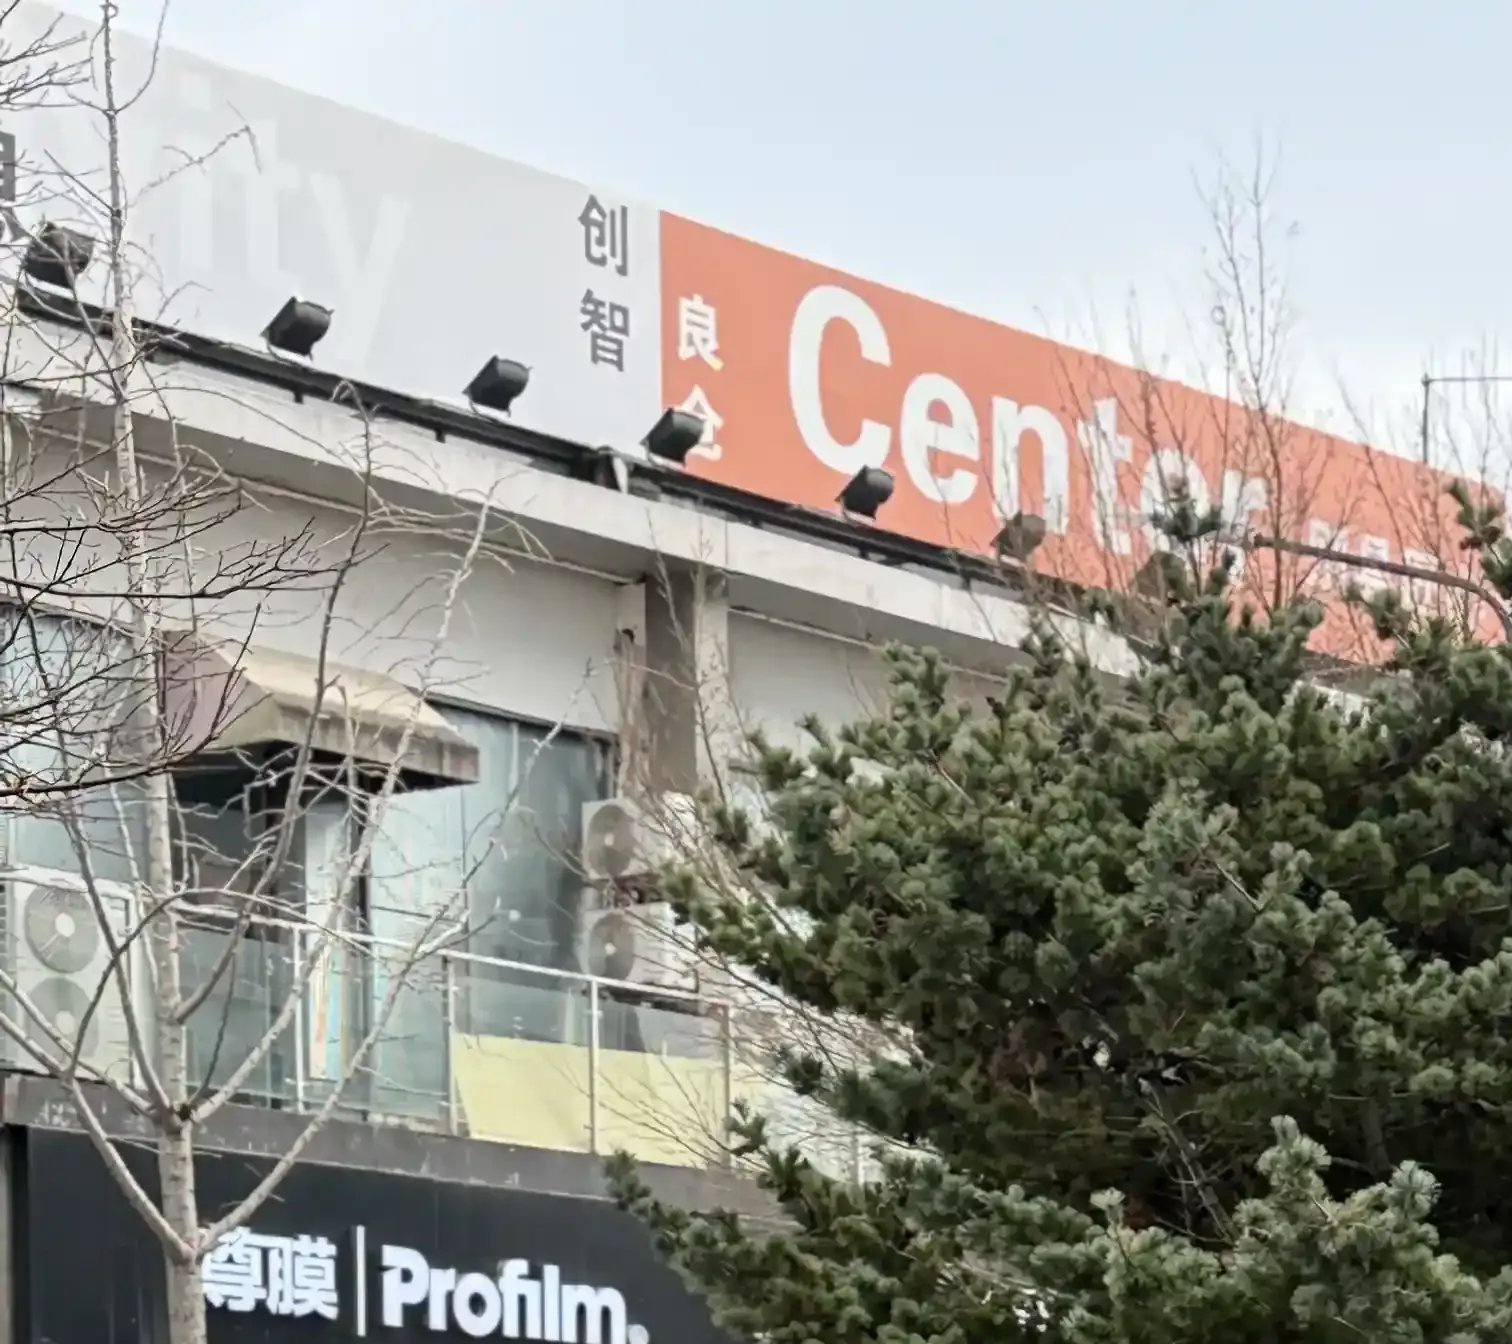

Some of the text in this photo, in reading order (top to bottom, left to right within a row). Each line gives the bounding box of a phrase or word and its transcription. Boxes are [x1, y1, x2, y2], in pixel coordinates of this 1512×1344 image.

[578, 193, 631, 373] 创智
[788, 284, 1269, 588] Center
[200, 1226, 340, 1320] 尊膜
